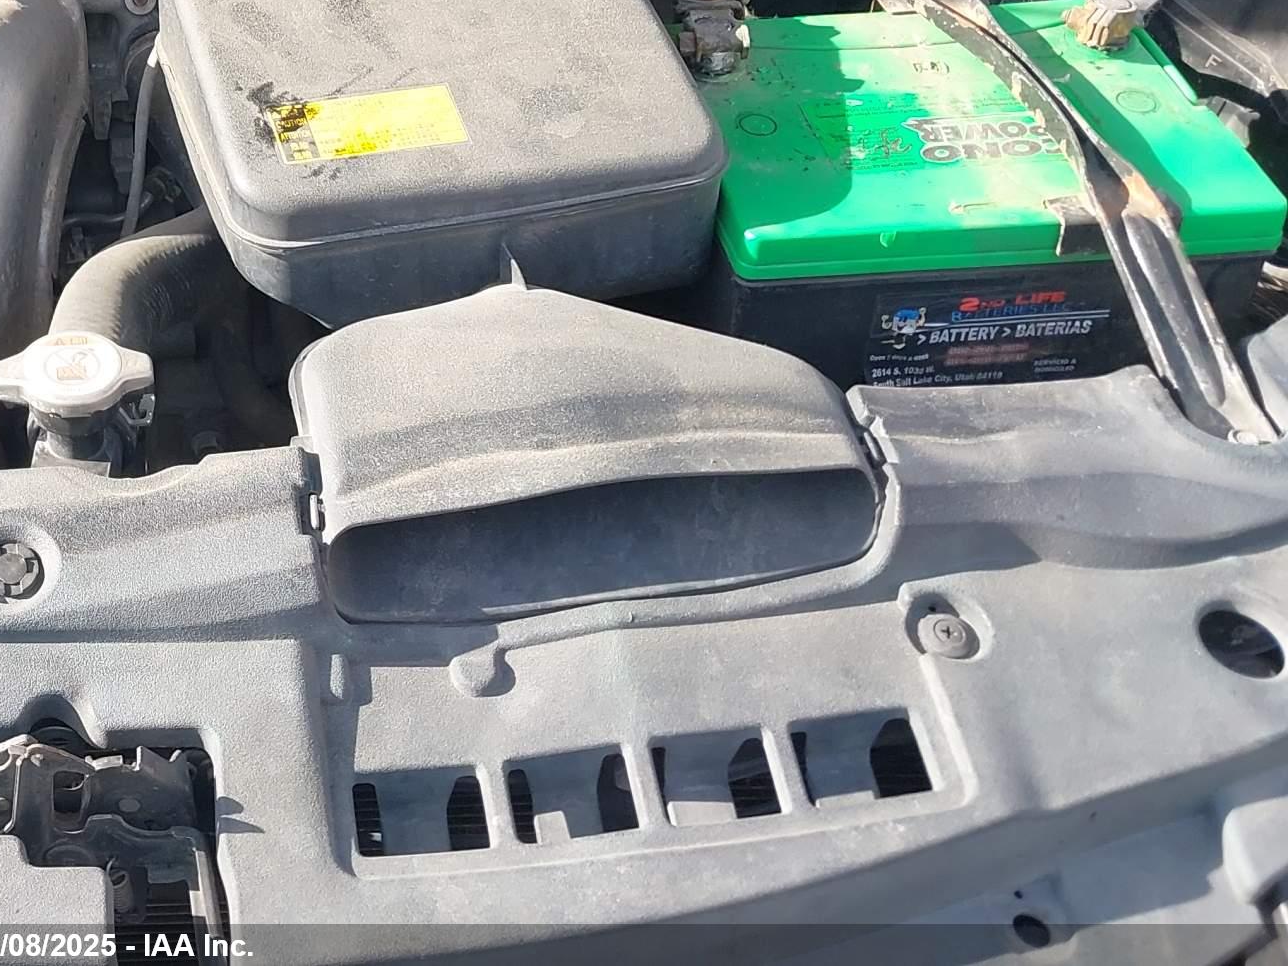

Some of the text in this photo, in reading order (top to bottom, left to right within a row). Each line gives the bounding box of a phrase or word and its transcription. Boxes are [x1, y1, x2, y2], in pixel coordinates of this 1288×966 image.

[920, 139, 1063, 162] CONO
[1015, 291, 1066, 304] LIFE
[929, 326, 999, 345] BATTERY
[1015, 320, 1093, 338] BATERIAS
